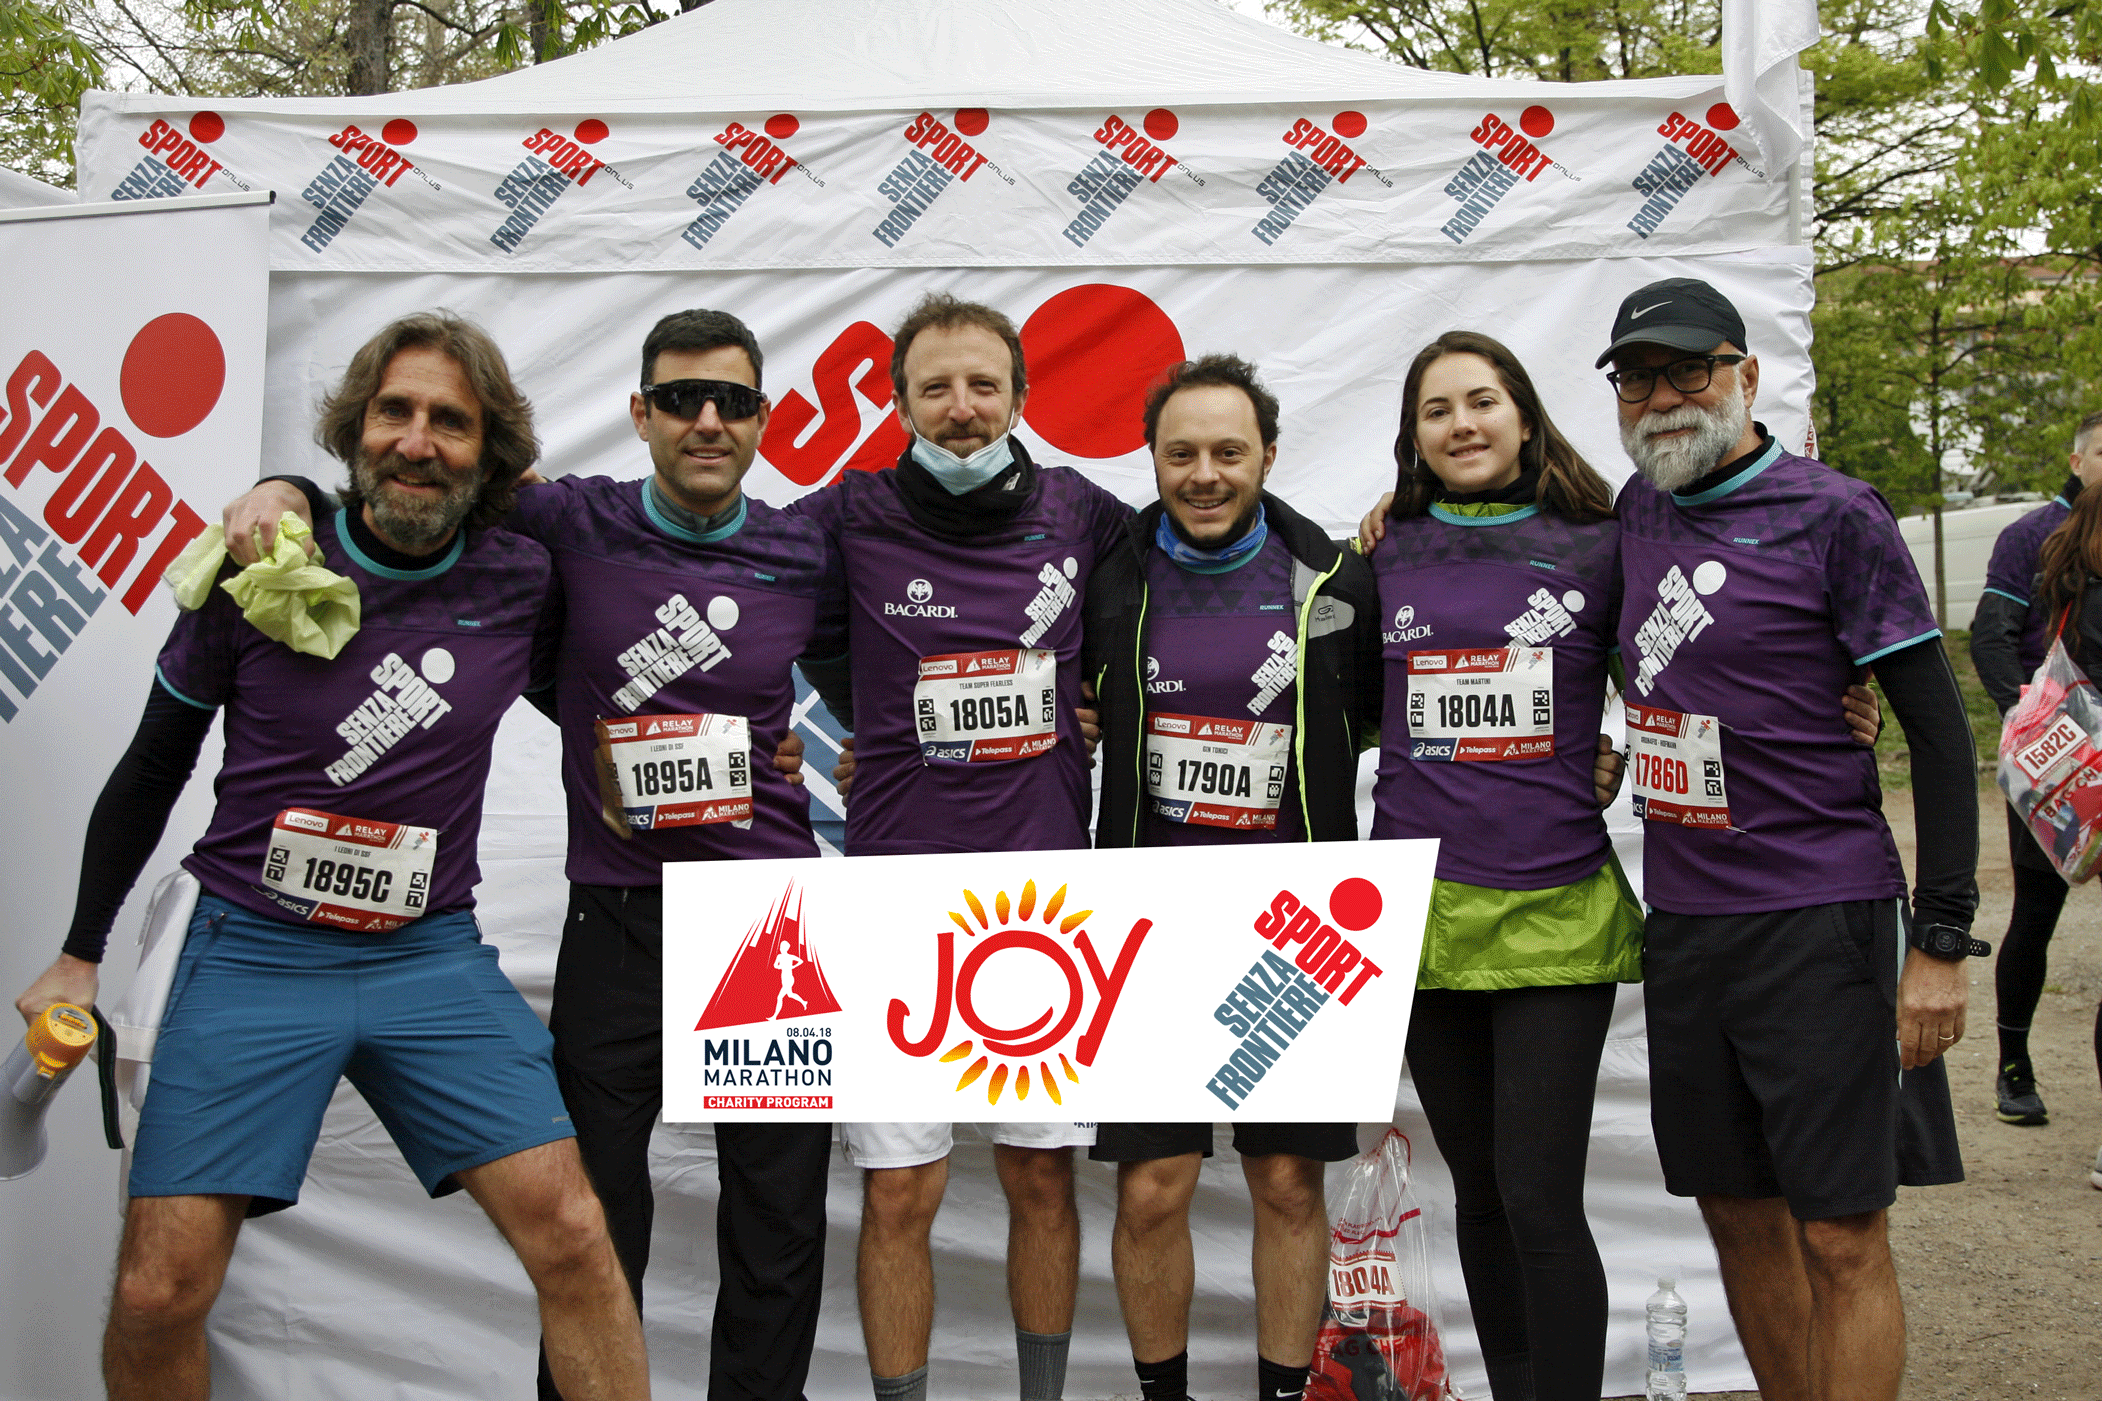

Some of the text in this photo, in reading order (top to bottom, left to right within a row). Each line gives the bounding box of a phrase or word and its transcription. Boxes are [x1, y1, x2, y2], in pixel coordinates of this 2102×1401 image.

[139, 119, 223, 189] SPORT
[329, 125, 414, 188] SPORT
[522, 128, 606, 187] SPORT
[714, 122, 798, 185] SPORT
[904, 111, 989, 182] SPORT
[1093, 114, 1178, 184] SPORT
[1282, 118, 1367, 184] SPORT
[1470, 113, 1553, 183] SPORT
[1632, 143, 1688, 198] SENZA
[1657, 112, 1739, 177] SPORT
[111, 155, 167, 201] SENZA
[301, 155, 358, 209] SENZA
[494, 155, 550, 209] SENZA
[686, 151, 743, 207] SENZA
[878, 149, 935, 203] SENZA
[1067, 150, 1123, 204] SENZA
[1256, 151, 1313, 205] SENZA
[1444, 149, 1500, 202] SENZA
[1627, 156, 1706, 239] FRONTIERE
[300, 169, 379, 254] FRONTIERE
[490, 168, 572, 254] FRONTIERE
[681, 165, 764, 250] FRONTIERE
[872, 162, 956, 248] FRONTIERE
[1062, 164, 1144, 248] FRONTIERE
[1251, 164, 1332, 247] FRONTIERE
[1441, 164, 1521, 245] FRONTIERE
[0, 349, 208, 617] SPORT
[1024, 586, 1056, 621] SENZA
[1038, 562, 1076, 608] SPORT
[1657, 564, 1714, 643] SPORT
[655, 594, 732, 672] SPORT
[1019, 596, 1065, 648] FRONTIERE
[1504, 609, 1545, 637] SENZA
[1527, 588, 1577, 638] SPORT
[1634, 602, 1672, 656] SENZA
[617, 628, 680, 677] SENZA
[923, 664, 953, 672] Lenovo
[981, 657, 1010, 665] RELAY
[1251, 653, 1287, 688] SENZA
[1267, 630, 1298, 668] SPO
[370, 652, 452, 730] SPORT
[611, 647, 696, 714] FRONTIERE
[960, 682, 973, 690] TEAM
[974, 681, 989, 689] SUPER
[1247, 663, 1298, 716] FRONTIERE
[336, 690, 400, 746] SENZA
[610, 727, 634, 735] enovo
[662, 720, 693, 728] RELAY
[950, 695, 1029, 731] 1805A
[1157, 718, 1186, 730] Lenovo
[1214, 725, 1243, 733] RELAY
[1438, 694, 1516, 727] 1804A
[1656, 715, 1675, 723] RELAY
[324, 706, 419, 787] FRONTIERE
[981, 747, 1012, 755] Telepass
[1466, 746, 1496, 754] Telepass
[1521, 741, 1550, 749] MILANO
[2024, 723, 2076, 770] 1582C
[632, 757, 713, 796] 1895A
[1178, 759, 1250, 798] 1790A
[1636, 752, 1688, 794] 1786D
[289, 814, 323, 828] Lenovo
[356, 826, 387, 836] RELAY
[665, 812, 695, 820] Telepass
[718, 804, 749, 812] MILANO
[1200, 811, 1230, 820] Telepass
[303, 857, 393, 903] 1895C
[325, 911, 359, 925] Telepass
[1332, 1265, 1395, 1297] 1804A
